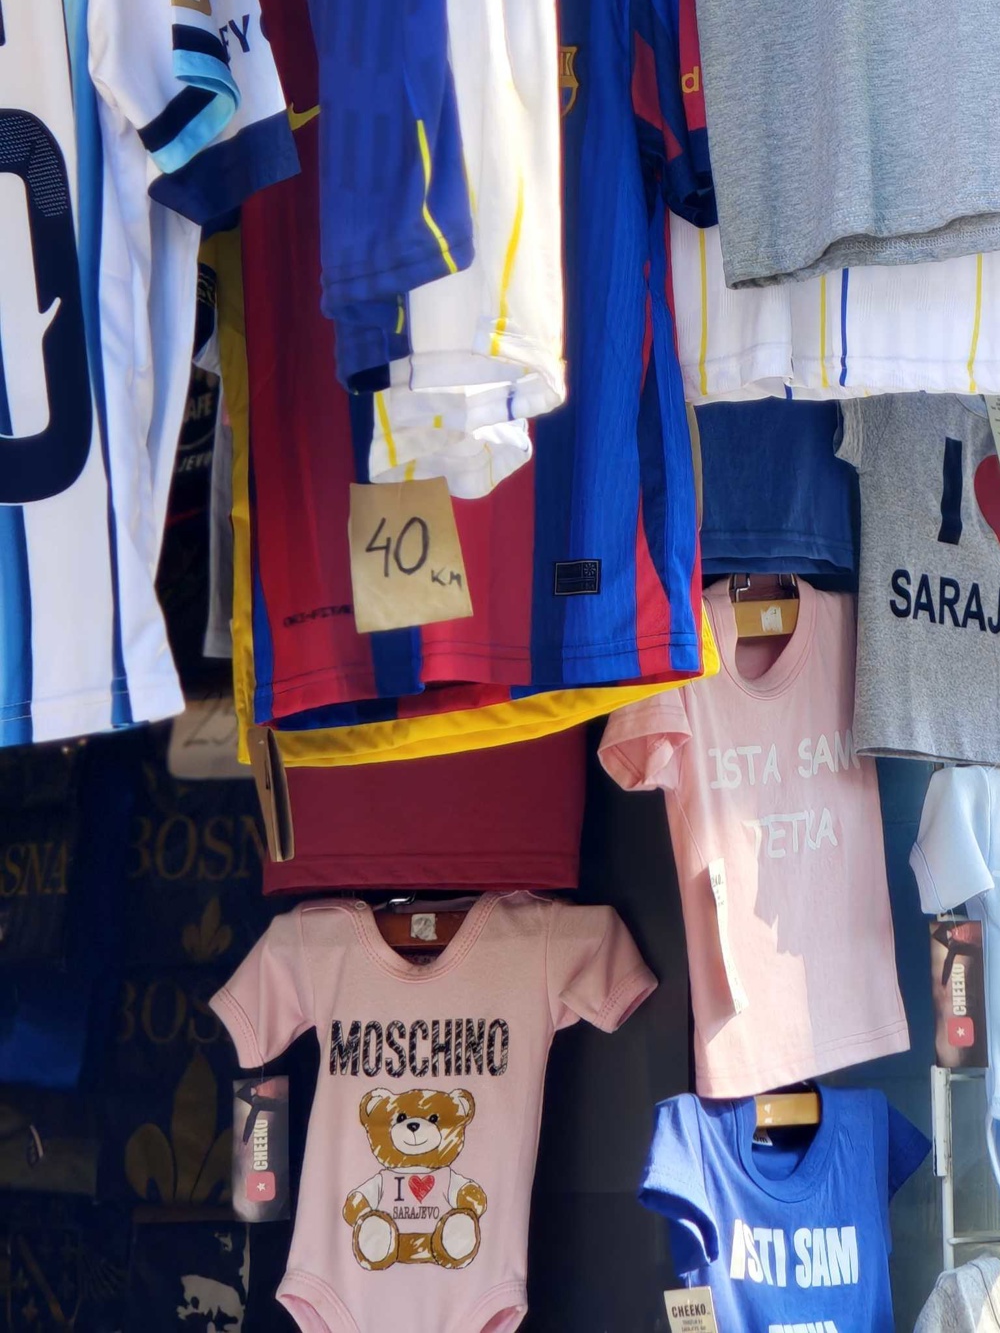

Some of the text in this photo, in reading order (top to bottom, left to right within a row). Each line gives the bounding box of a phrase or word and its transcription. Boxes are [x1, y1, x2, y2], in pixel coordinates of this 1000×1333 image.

[937, 436, 963, 546] I
[365, 516, 464, 592] 40 KM
[707, 743, 782, 790] ISTA
[328, 1017, 510, 1078] MOSCHINO
[252, 1118, 269, 1171] CHEEKO
[391, 1205, 440, 1220] SARAJEVO
[393, 1176, 405, 1202] I
[729, 1218, 860, 1289] ISTI SAM
[671, 1303, 707, 1318] CHEEKO
